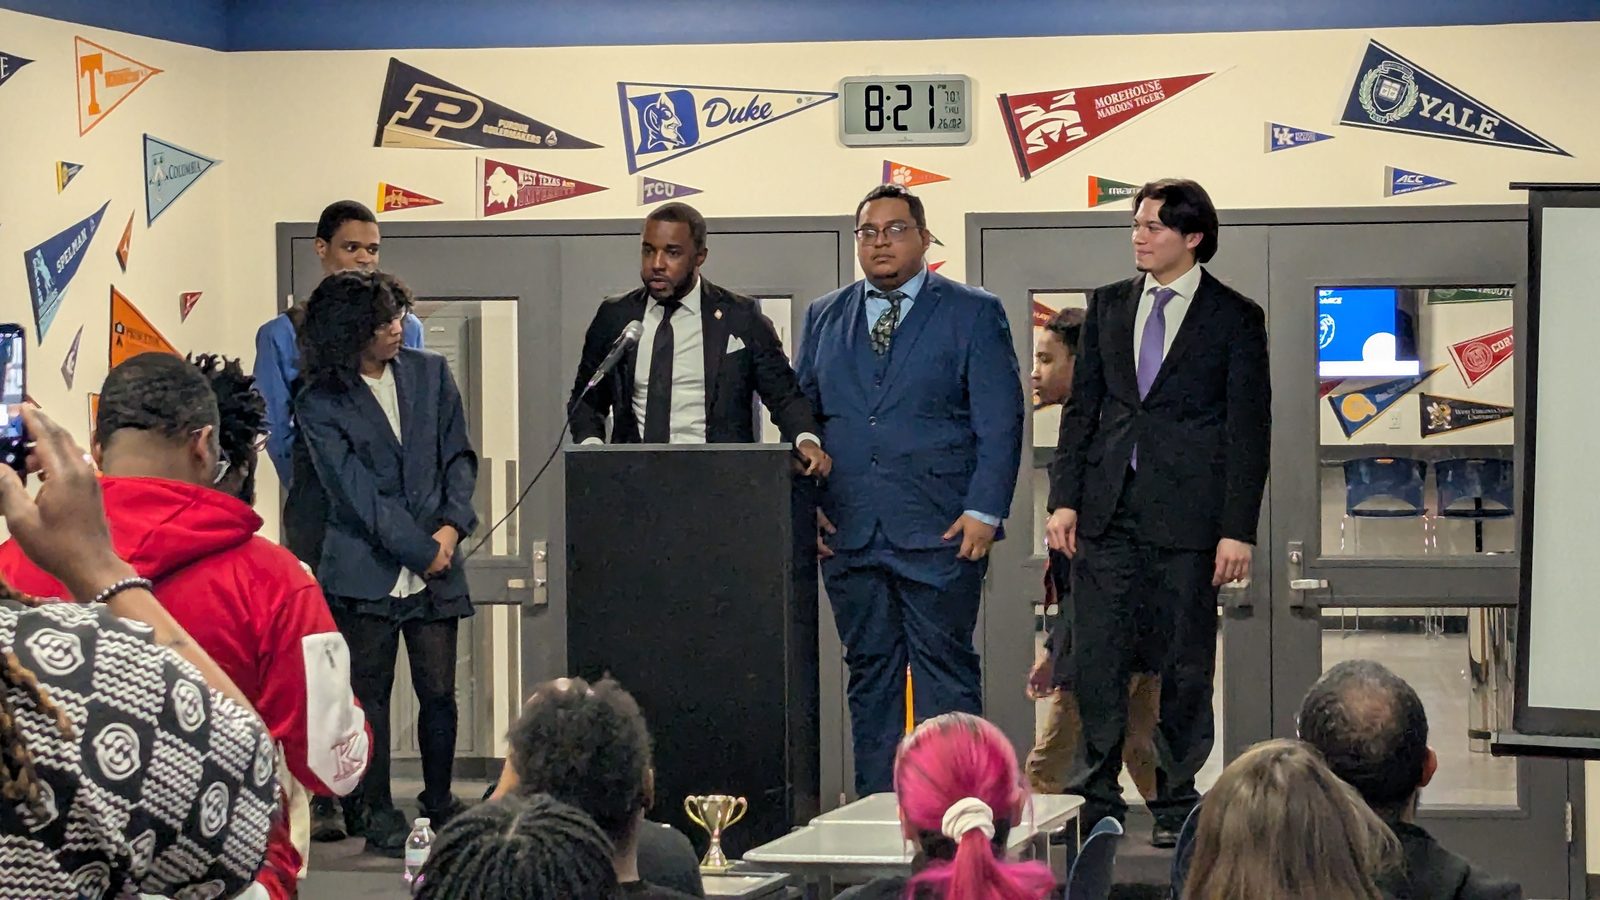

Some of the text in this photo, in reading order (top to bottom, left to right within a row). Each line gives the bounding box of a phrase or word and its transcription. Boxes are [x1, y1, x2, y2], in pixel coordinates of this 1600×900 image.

[865, 84, 935, 132] 8:21
[1095, 80, 1162, 109] MOREHOUSE
[1097, 91, 1166, 119] MAROON TIGERS
[702, 94, 774, 128] Duke
[1417, 92, 1500, 140] YALE
[539, 174, 561, 187] TEXAS
[645, 182, 676, 197] TCU
[1396, 174, 1425, 184] ACC
[56, 227, 88, 274] SPELMAN
